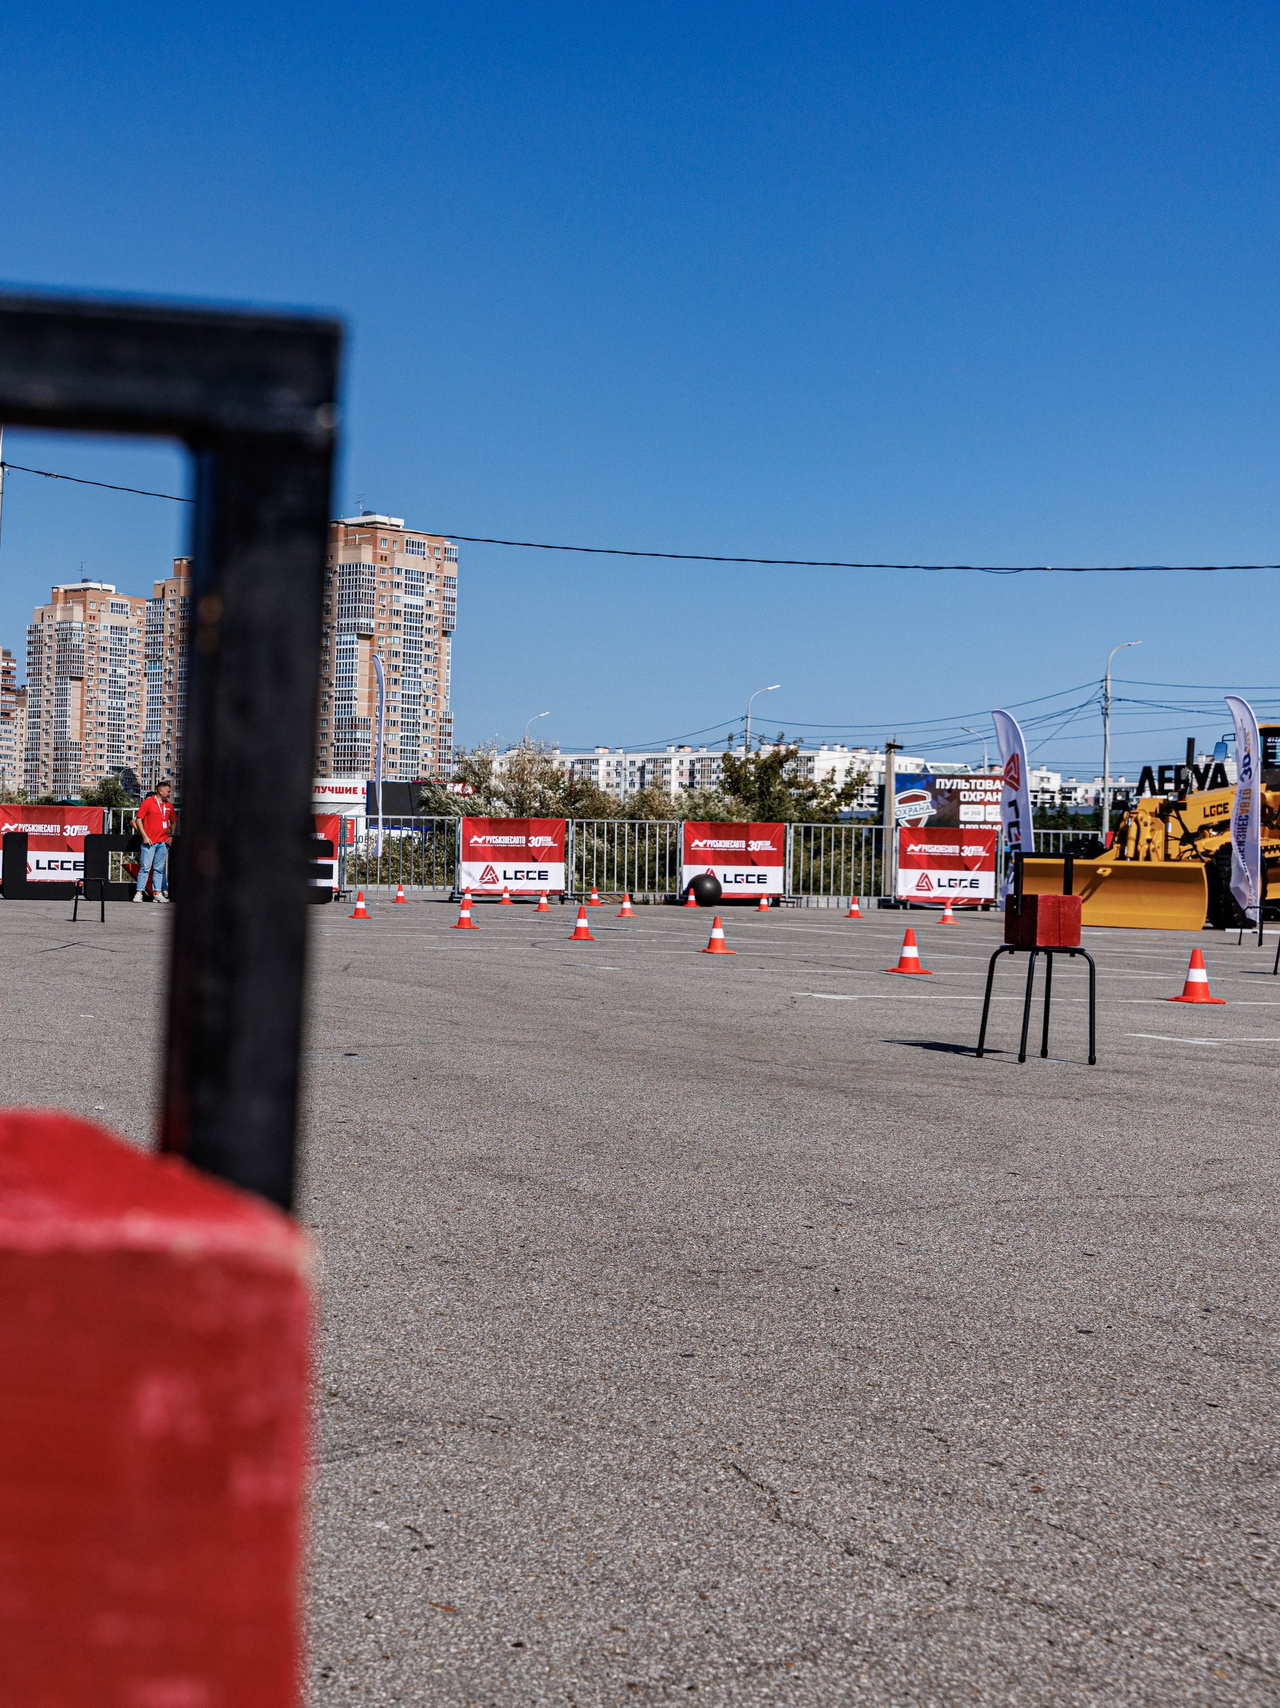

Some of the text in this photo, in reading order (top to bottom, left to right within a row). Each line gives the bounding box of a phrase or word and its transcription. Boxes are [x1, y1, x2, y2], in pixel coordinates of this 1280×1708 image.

[935, 778, 1004, 790] ПУЛЬТОВА
[959, 791, 1001, 802] ОХРАН
[1203, 802, 1229, 818] LGCE
[62, 825, 77, 836] 30
[527, 836, 541, 847] 30
[747, 840, 761, 851] 30
[961, 845, 974, 857] 30
[35, 859, 85, 871] LGCE
[503, 870, 549, 880] LGCE
[723, 873, 768, 884] LGCE
[937, 878, 980, 888] LGCE
